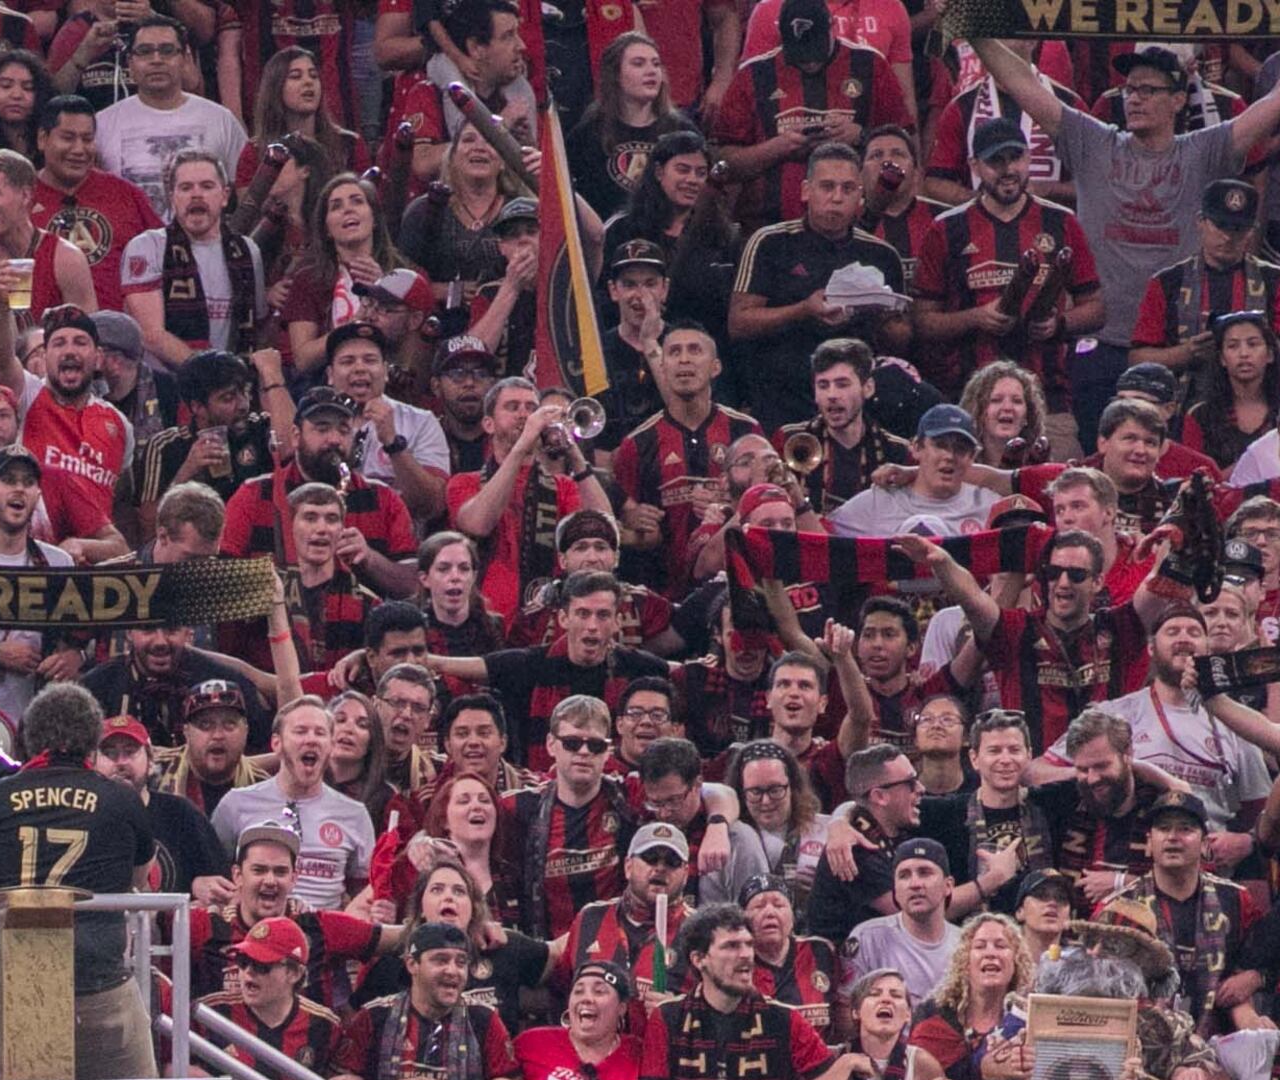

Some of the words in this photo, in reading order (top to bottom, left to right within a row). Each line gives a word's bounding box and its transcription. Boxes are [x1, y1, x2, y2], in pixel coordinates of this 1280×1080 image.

[1020, 0, 1097, 33] WE
[10, 787, 98, 813] SPENCER
[19, 826, 89, 888] 17
